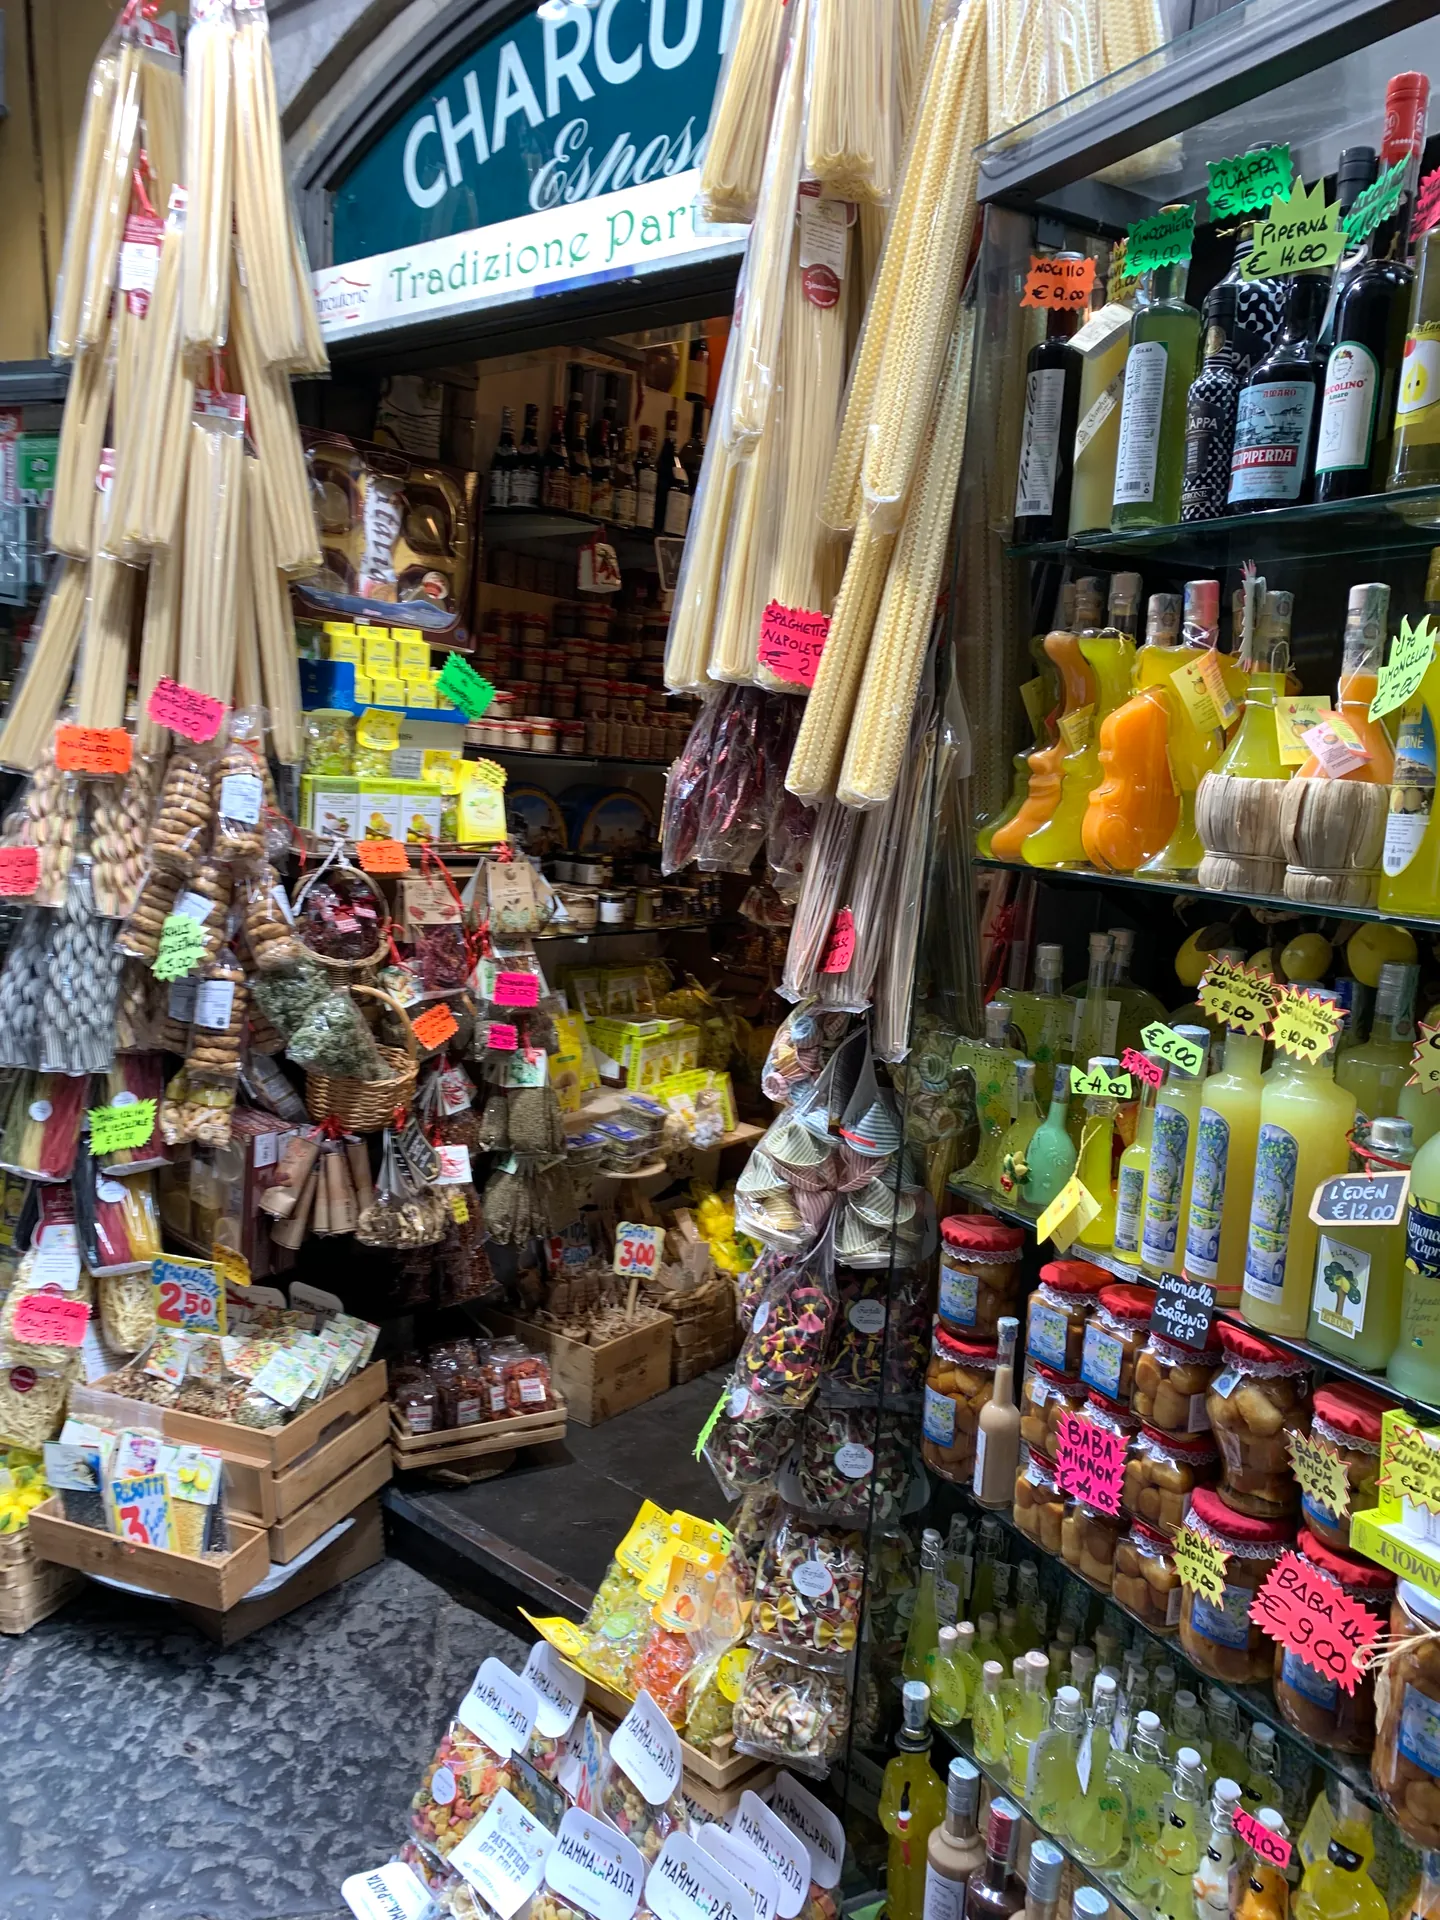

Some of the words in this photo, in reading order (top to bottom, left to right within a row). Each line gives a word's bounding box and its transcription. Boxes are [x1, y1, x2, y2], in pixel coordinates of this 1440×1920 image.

[1213, 193, 1234, 209] €
[389, 232, 591, 302] Tradizione
[1130, 250, 1143, 267] €
[1245, 250, 1271, 275] €
[1032, 285, 1049, 300] €
[1371, 694, 1386, 715] €
[1174, 1296, 1186, 1312] di
[557, 1833, 595, 1869] MAMMA
[604, 1863, 636, 1898] PASTA
[659, 1854, 699, 1903] MAMMA
